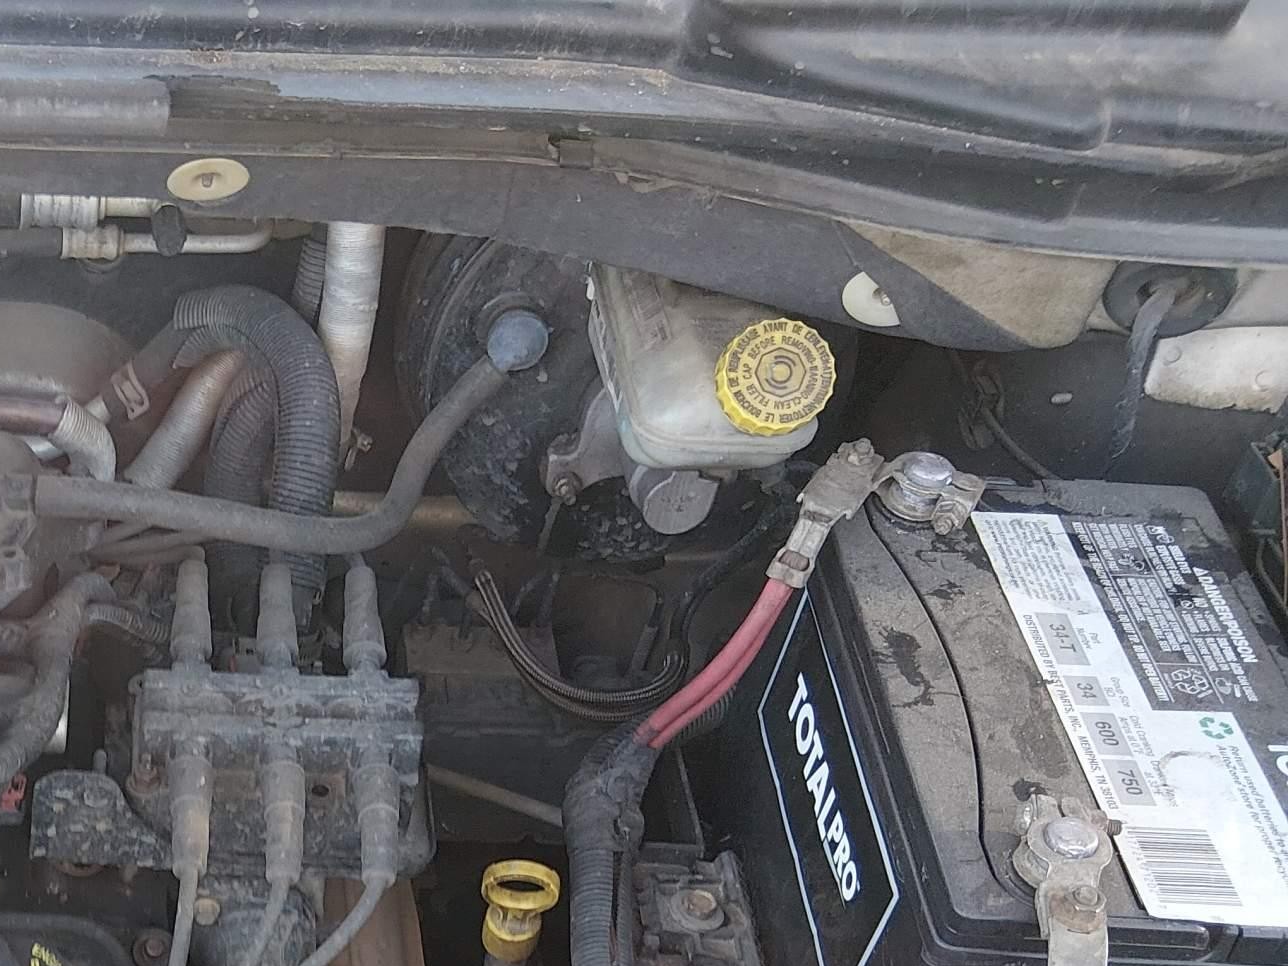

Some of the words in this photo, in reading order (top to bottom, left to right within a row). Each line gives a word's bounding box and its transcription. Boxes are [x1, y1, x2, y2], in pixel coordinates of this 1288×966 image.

[747, 336, 776, 360] BEFORE
[742, 363, 752, 380] CAP
[746, 383, 770, 408] FILLER
[1021, 614, 1050, 658] DISTRIBUTED
[1048, 623, 1076, 653] 34-T
[1042, 659, 1055, 668] BY
[1046, 669, 1064, 688] BEST
[1075, 682, 1097, 699] 34
[1055, 688, 1075, 714] PARTS,
[1094, 720, 1119, 746] 600
[1076, 735, 1102, 773] MEMPHIS,
[1093, 774, 1107, 784] TN
[1116, 768, 1143, 796] 750
[1228, 745, 1250, 773] Return
[1243, 775, 1262, 796] used
[788, 671, 857, 901] TOTALPRO
[1098, 786, 1118, 809] 38103
[1236, 787, 1255, 809] store
